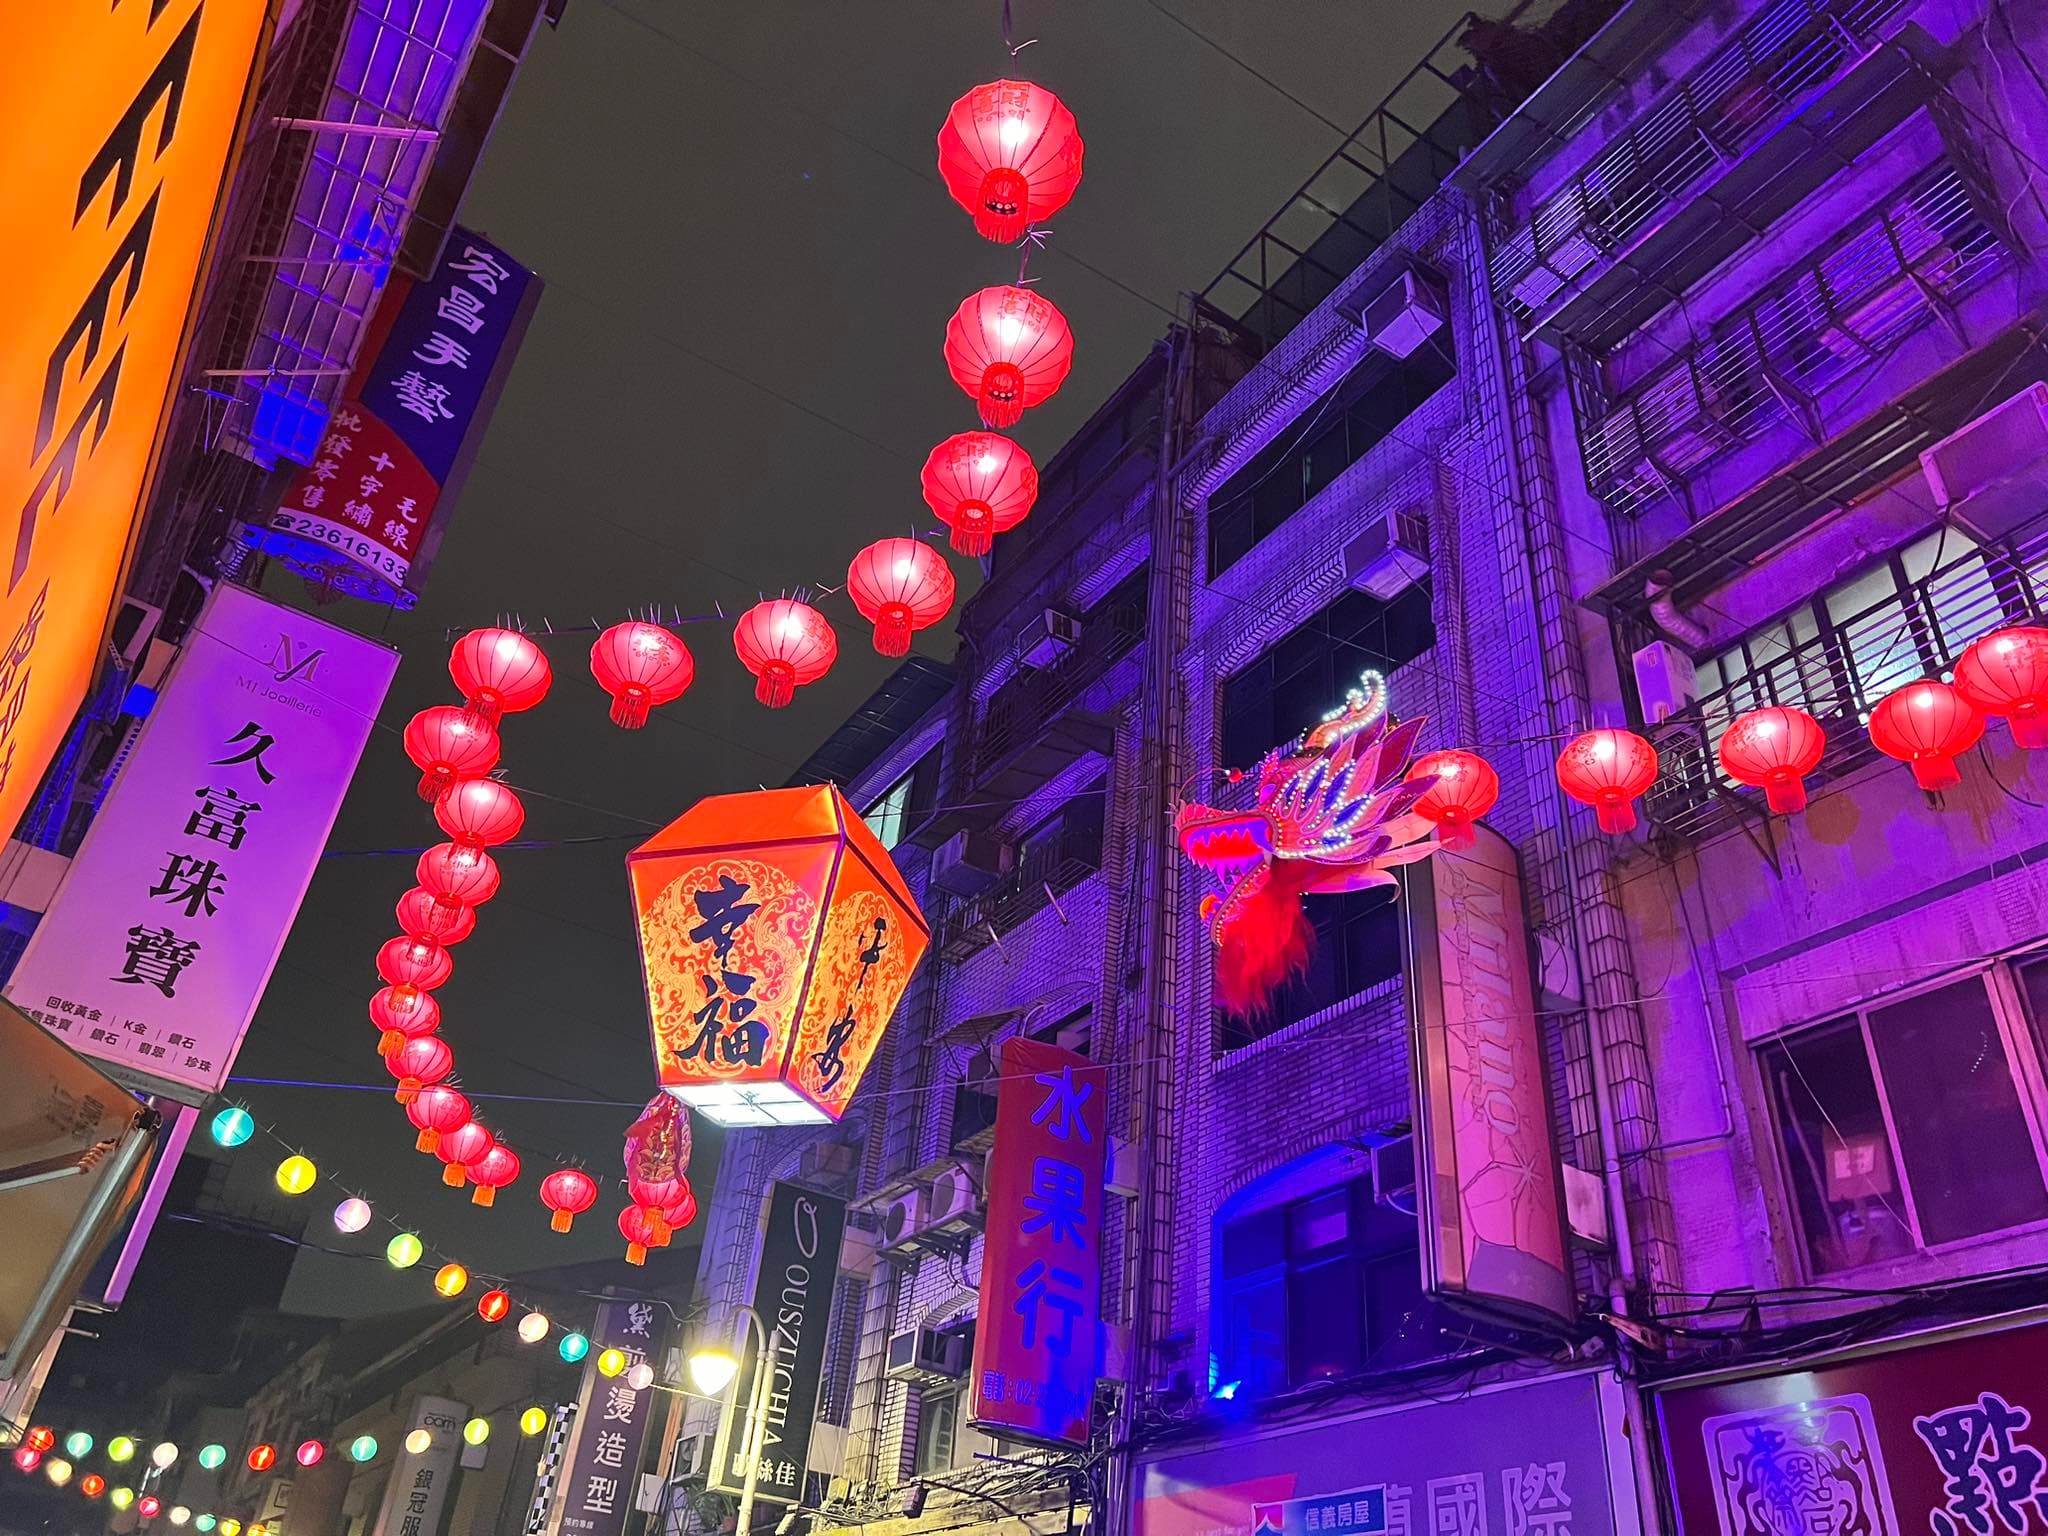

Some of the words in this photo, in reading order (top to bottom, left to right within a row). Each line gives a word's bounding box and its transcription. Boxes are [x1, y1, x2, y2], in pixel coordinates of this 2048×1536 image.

[391, 245, 511, 424] 宏昌手藝
[301, 409, 363, 509] 批發零售
[341, 451, 396, 529] 十字繡
[296, 519, 408, 581] 23616133
[383, 496, 418, 551] 毛線
[108, 720, 277, 999] 久富珠寶
[671, 873, 770, 1067] 幸福
[45, 995, 103, 1023] 回收黃金
[123, 1019, 148, 1037] K金
[137, 1041, 167, 1059] 翡翠
[184, 1055, 213, 1073] 珍珠
[1013, 1065, 1093, 1358] 水果行
[1305, 1500, 1370, 1531] 信義房屋
